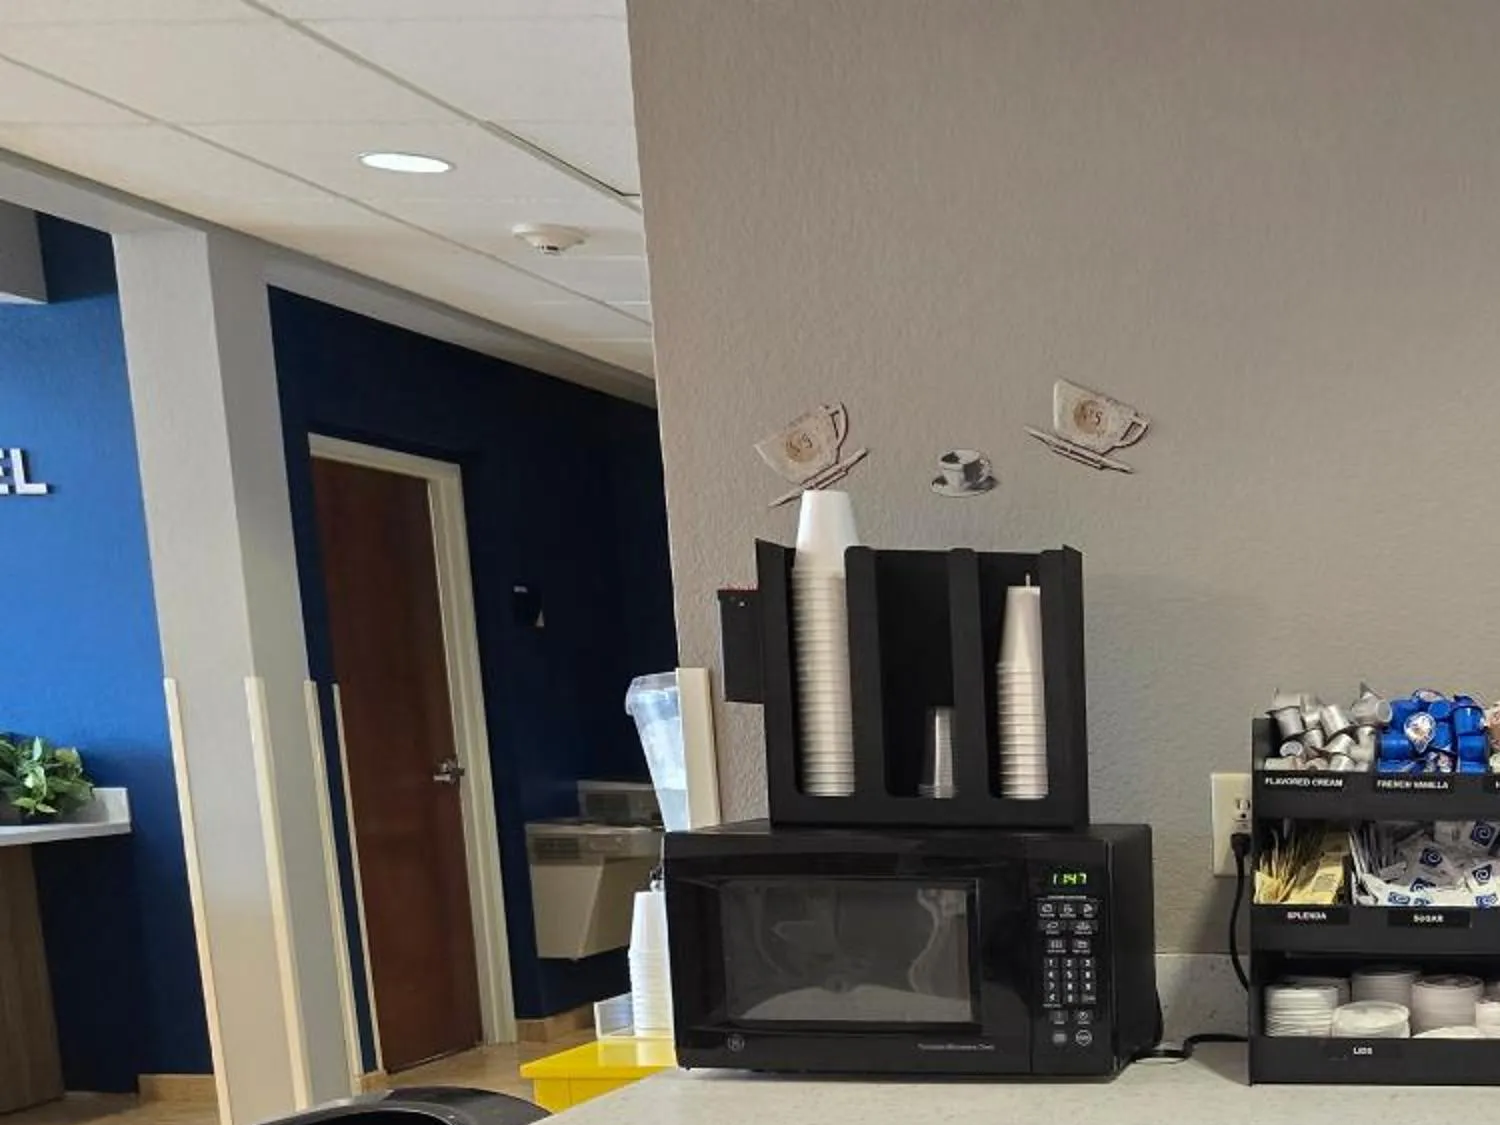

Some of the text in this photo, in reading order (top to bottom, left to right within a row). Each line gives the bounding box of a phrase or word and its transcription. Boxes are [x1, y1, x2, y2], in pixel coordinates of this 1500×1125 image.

[1264, 777, 1344, 788] FLAVORED CREAM
[1376, 779, 1449, 790] FRENCH VANILLA
[1286, 911, 1328, 921] SPLENDA
[1412, 914, 1444, 924] SUGAR
